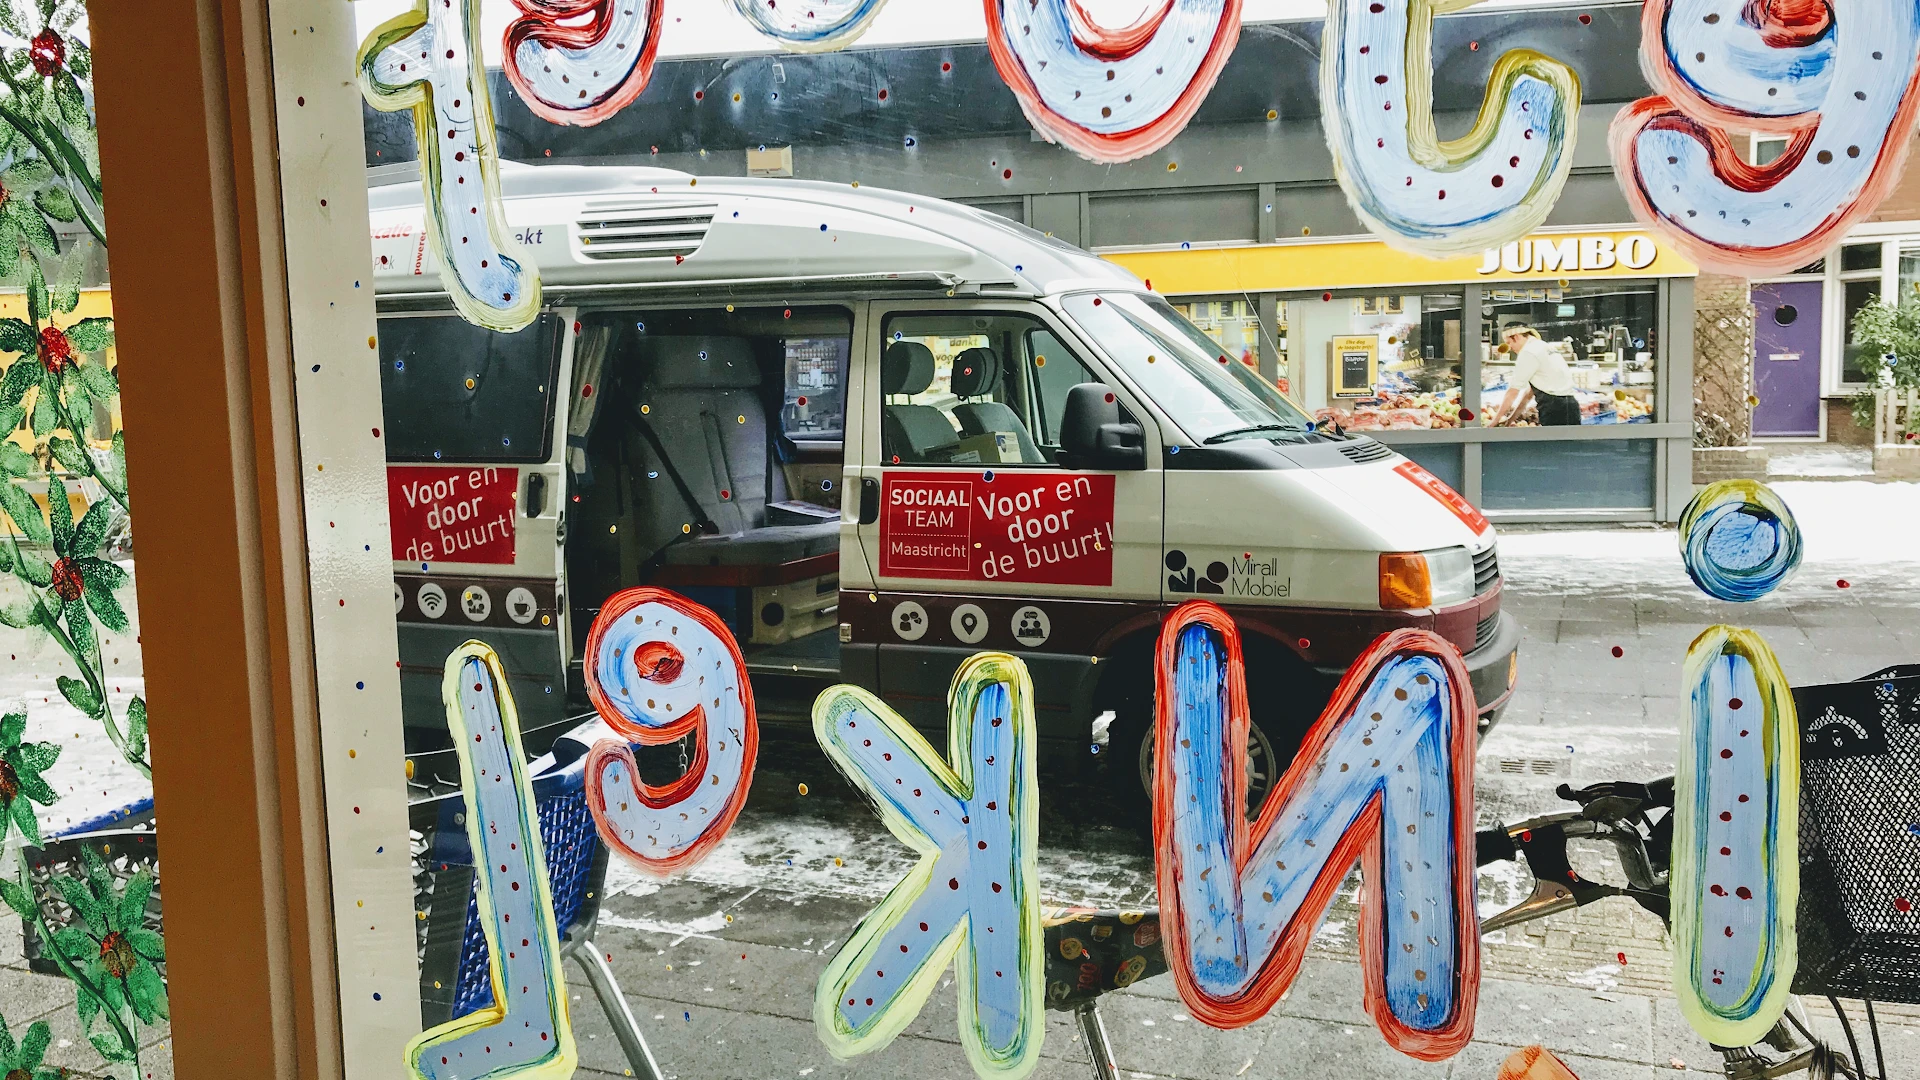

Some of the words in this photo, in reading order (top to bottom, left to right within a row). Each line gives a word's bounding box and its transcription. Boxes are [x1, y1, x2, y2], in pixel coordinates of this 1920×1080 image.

[1476, 235, 1658, 275] JUMBO
[402, 475, 460, 508] Voor
[468, 467, 499, 490] en
[891, 488, 970, 508] SOCIAAL
[976, 485, 1046, 521] Voor
[1055, 476, 1092, 502] en
[426, 496, 483, 531] door
[904, 510, 954, 528] TEAM
[1006, 508, 1075, 544] door
[405, 538, 434, 562] de
[891, 541, 967, 558] Maastricht
[981, 550, 1016, 579] de
[1023, 522, 1114, 569] buurt!
[1232, 556, 1278, 577] Mirall
[1231, 577, 1291, 598] Mobiel
